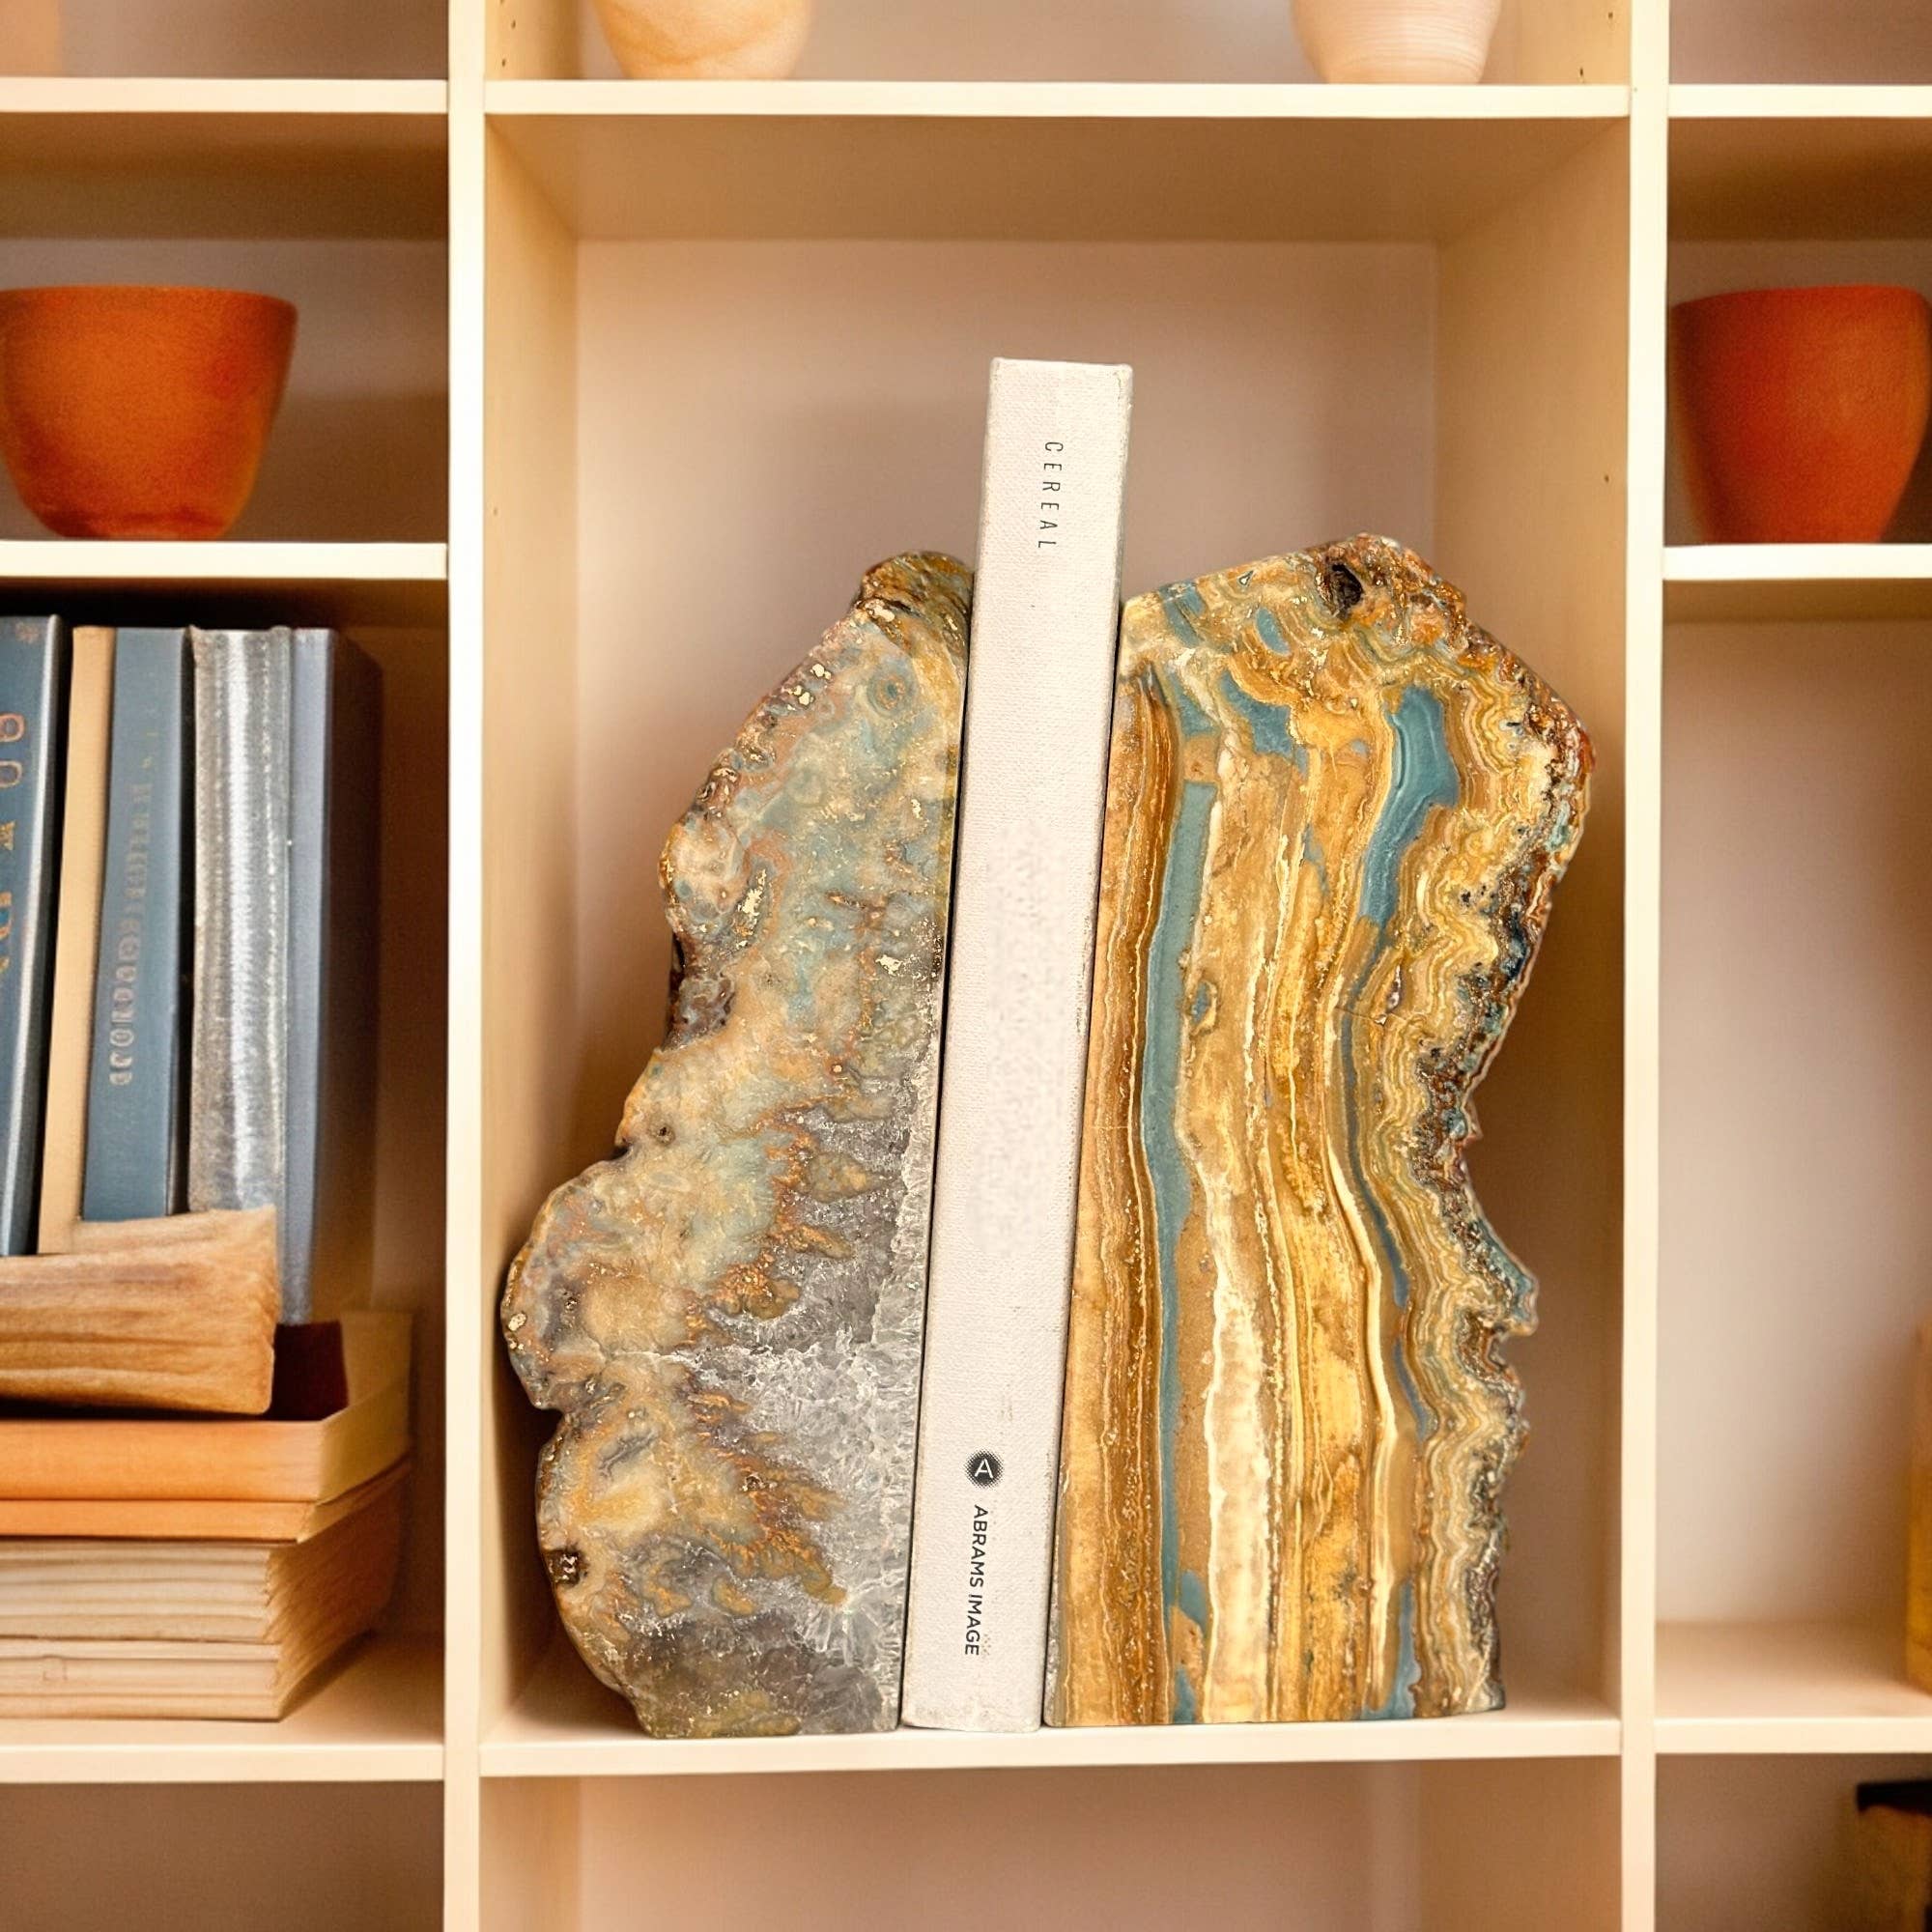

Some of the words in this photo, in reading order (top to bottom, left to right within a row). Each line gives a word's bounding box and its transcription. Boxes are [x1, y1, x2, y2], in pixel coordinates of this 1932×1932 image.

[1038, 442, 1063, 548] CEREAL
[970, 1505, 988, 1587] ABRAMS
[965, 1595, 982, 1655] IMAGE
